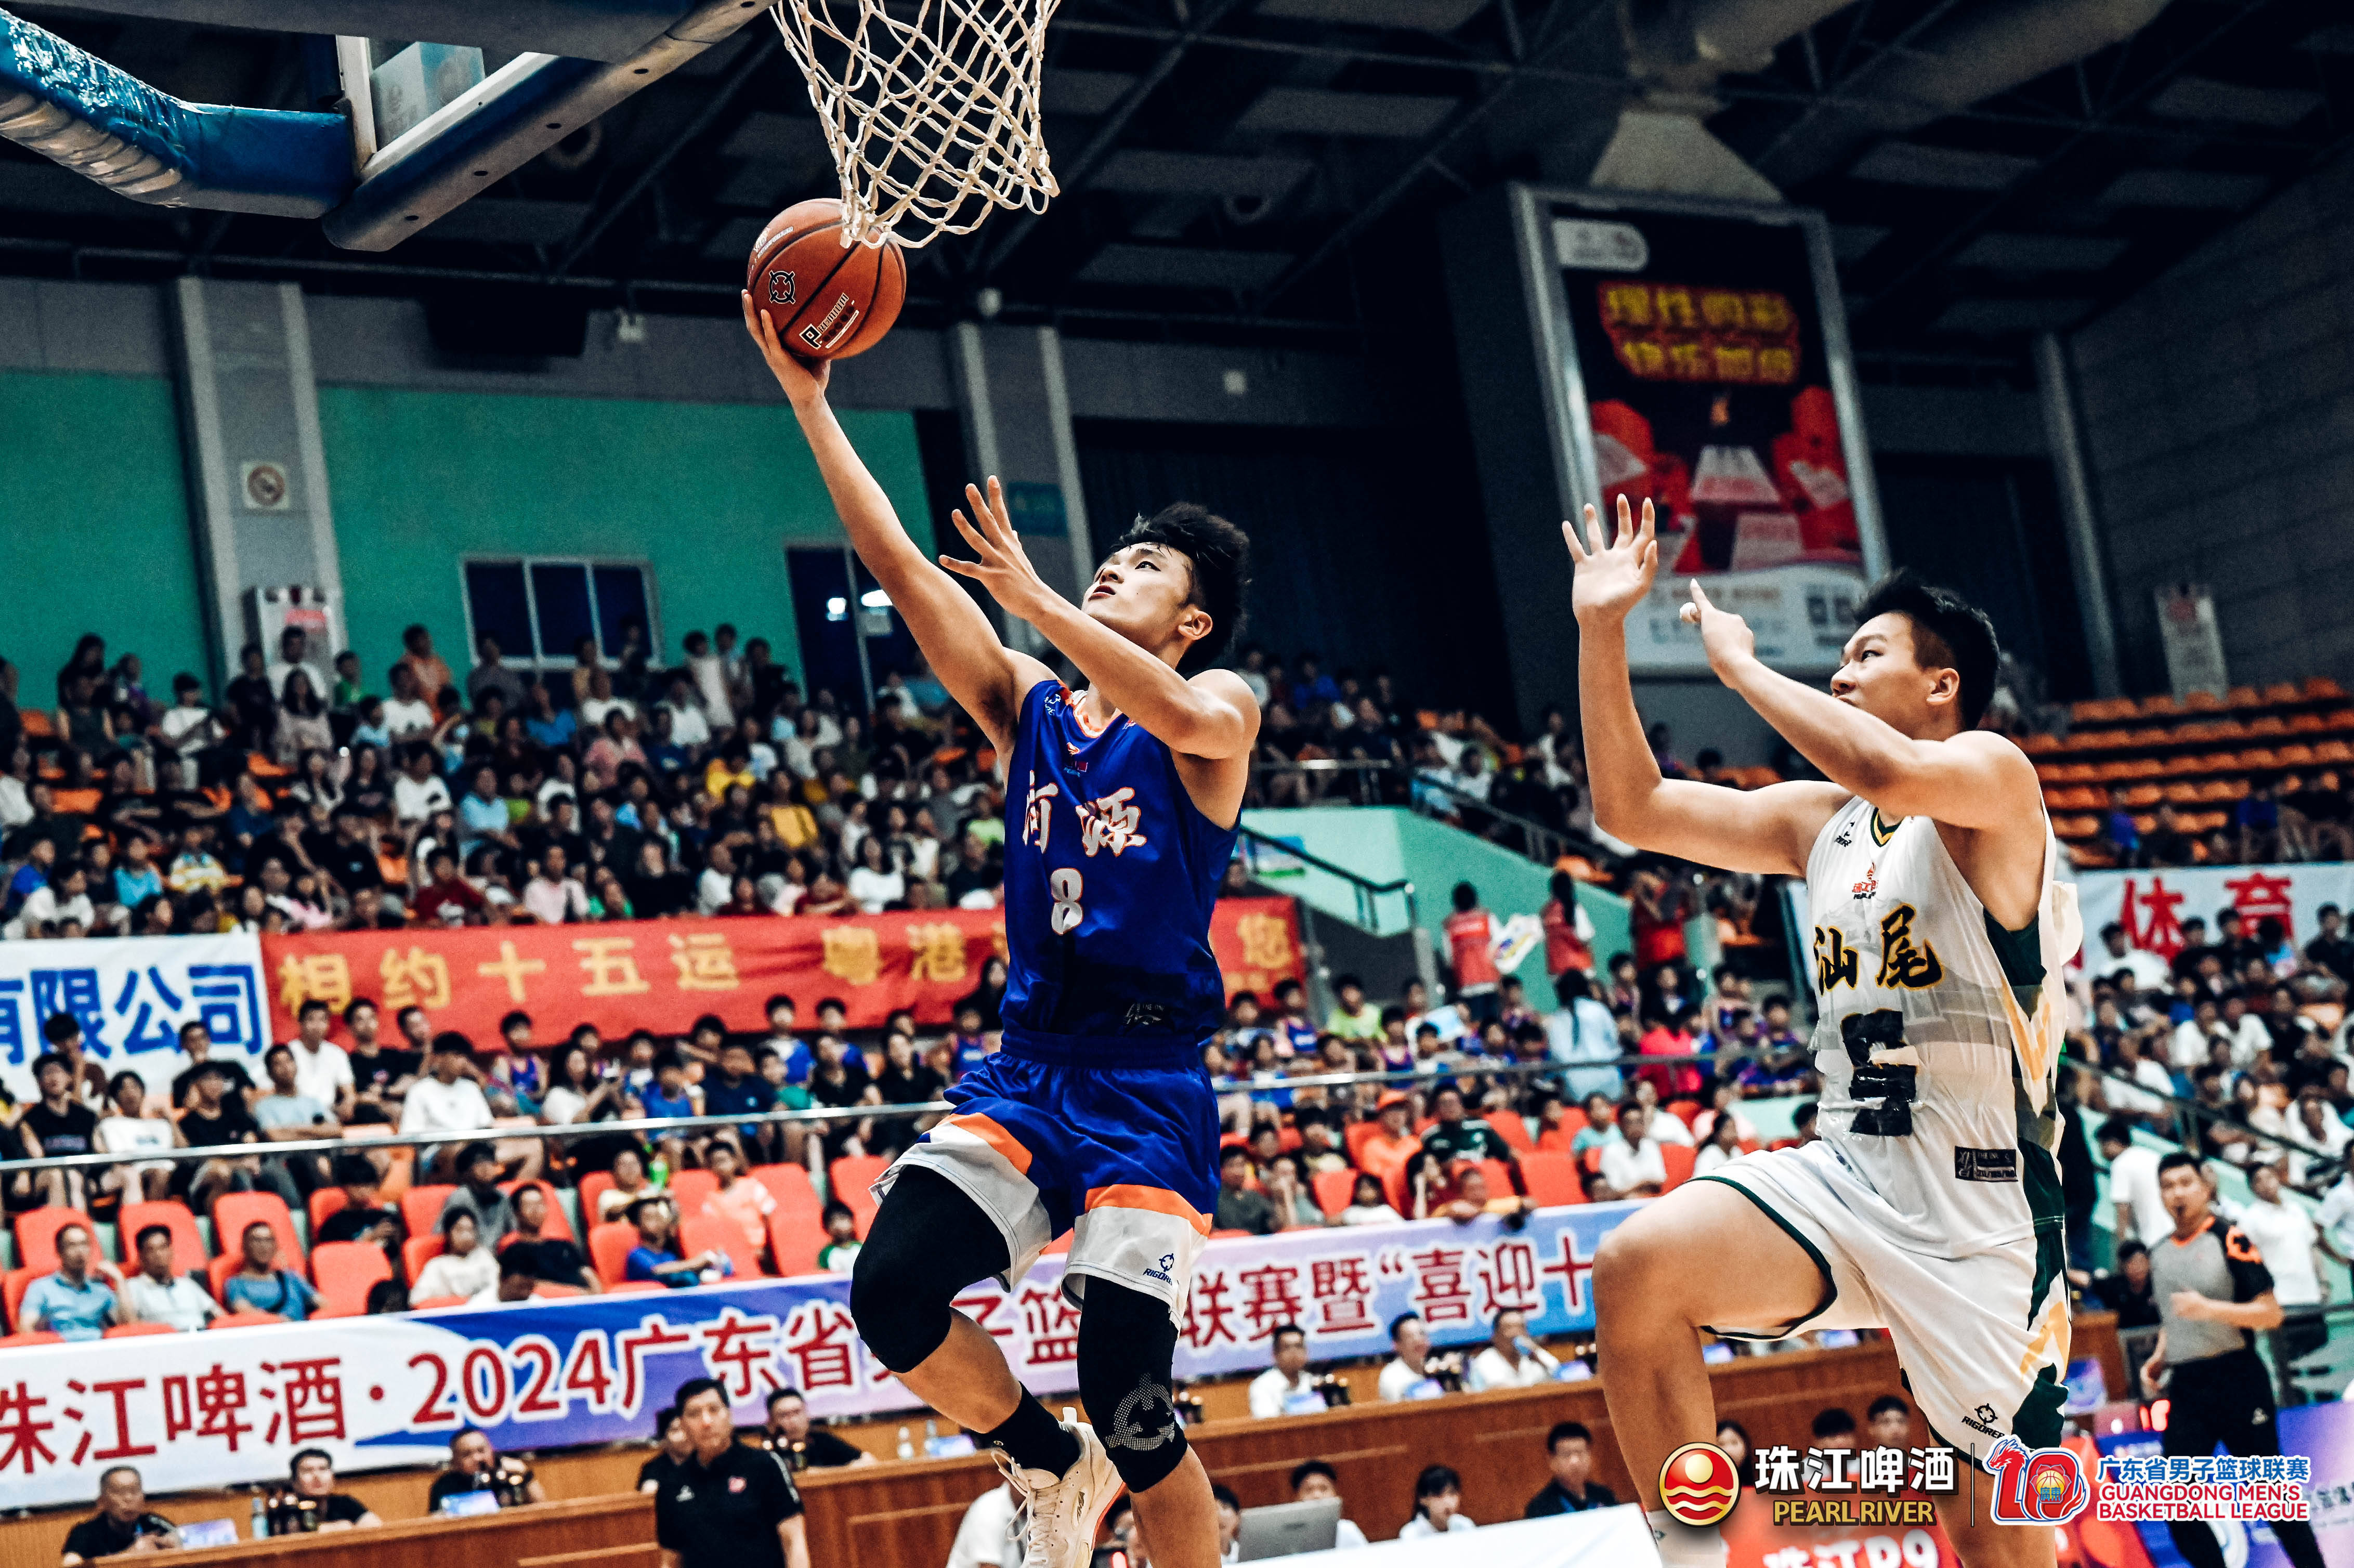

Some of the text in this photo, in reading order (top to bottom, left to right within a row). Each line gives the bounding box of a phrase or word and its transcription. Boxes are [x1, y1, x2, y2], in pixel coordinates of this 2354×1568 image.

[1050, 868, 1083, 936] 8
[2066, 872, 2294, 969] 体育
[277, 933, 740, 1017] 相约十五运
[820, 922, 1010, 986] 粤港
[1813, 903, 1944, 997] 汕尾
[1142, 1268, 1173, 1286] RIGORE
